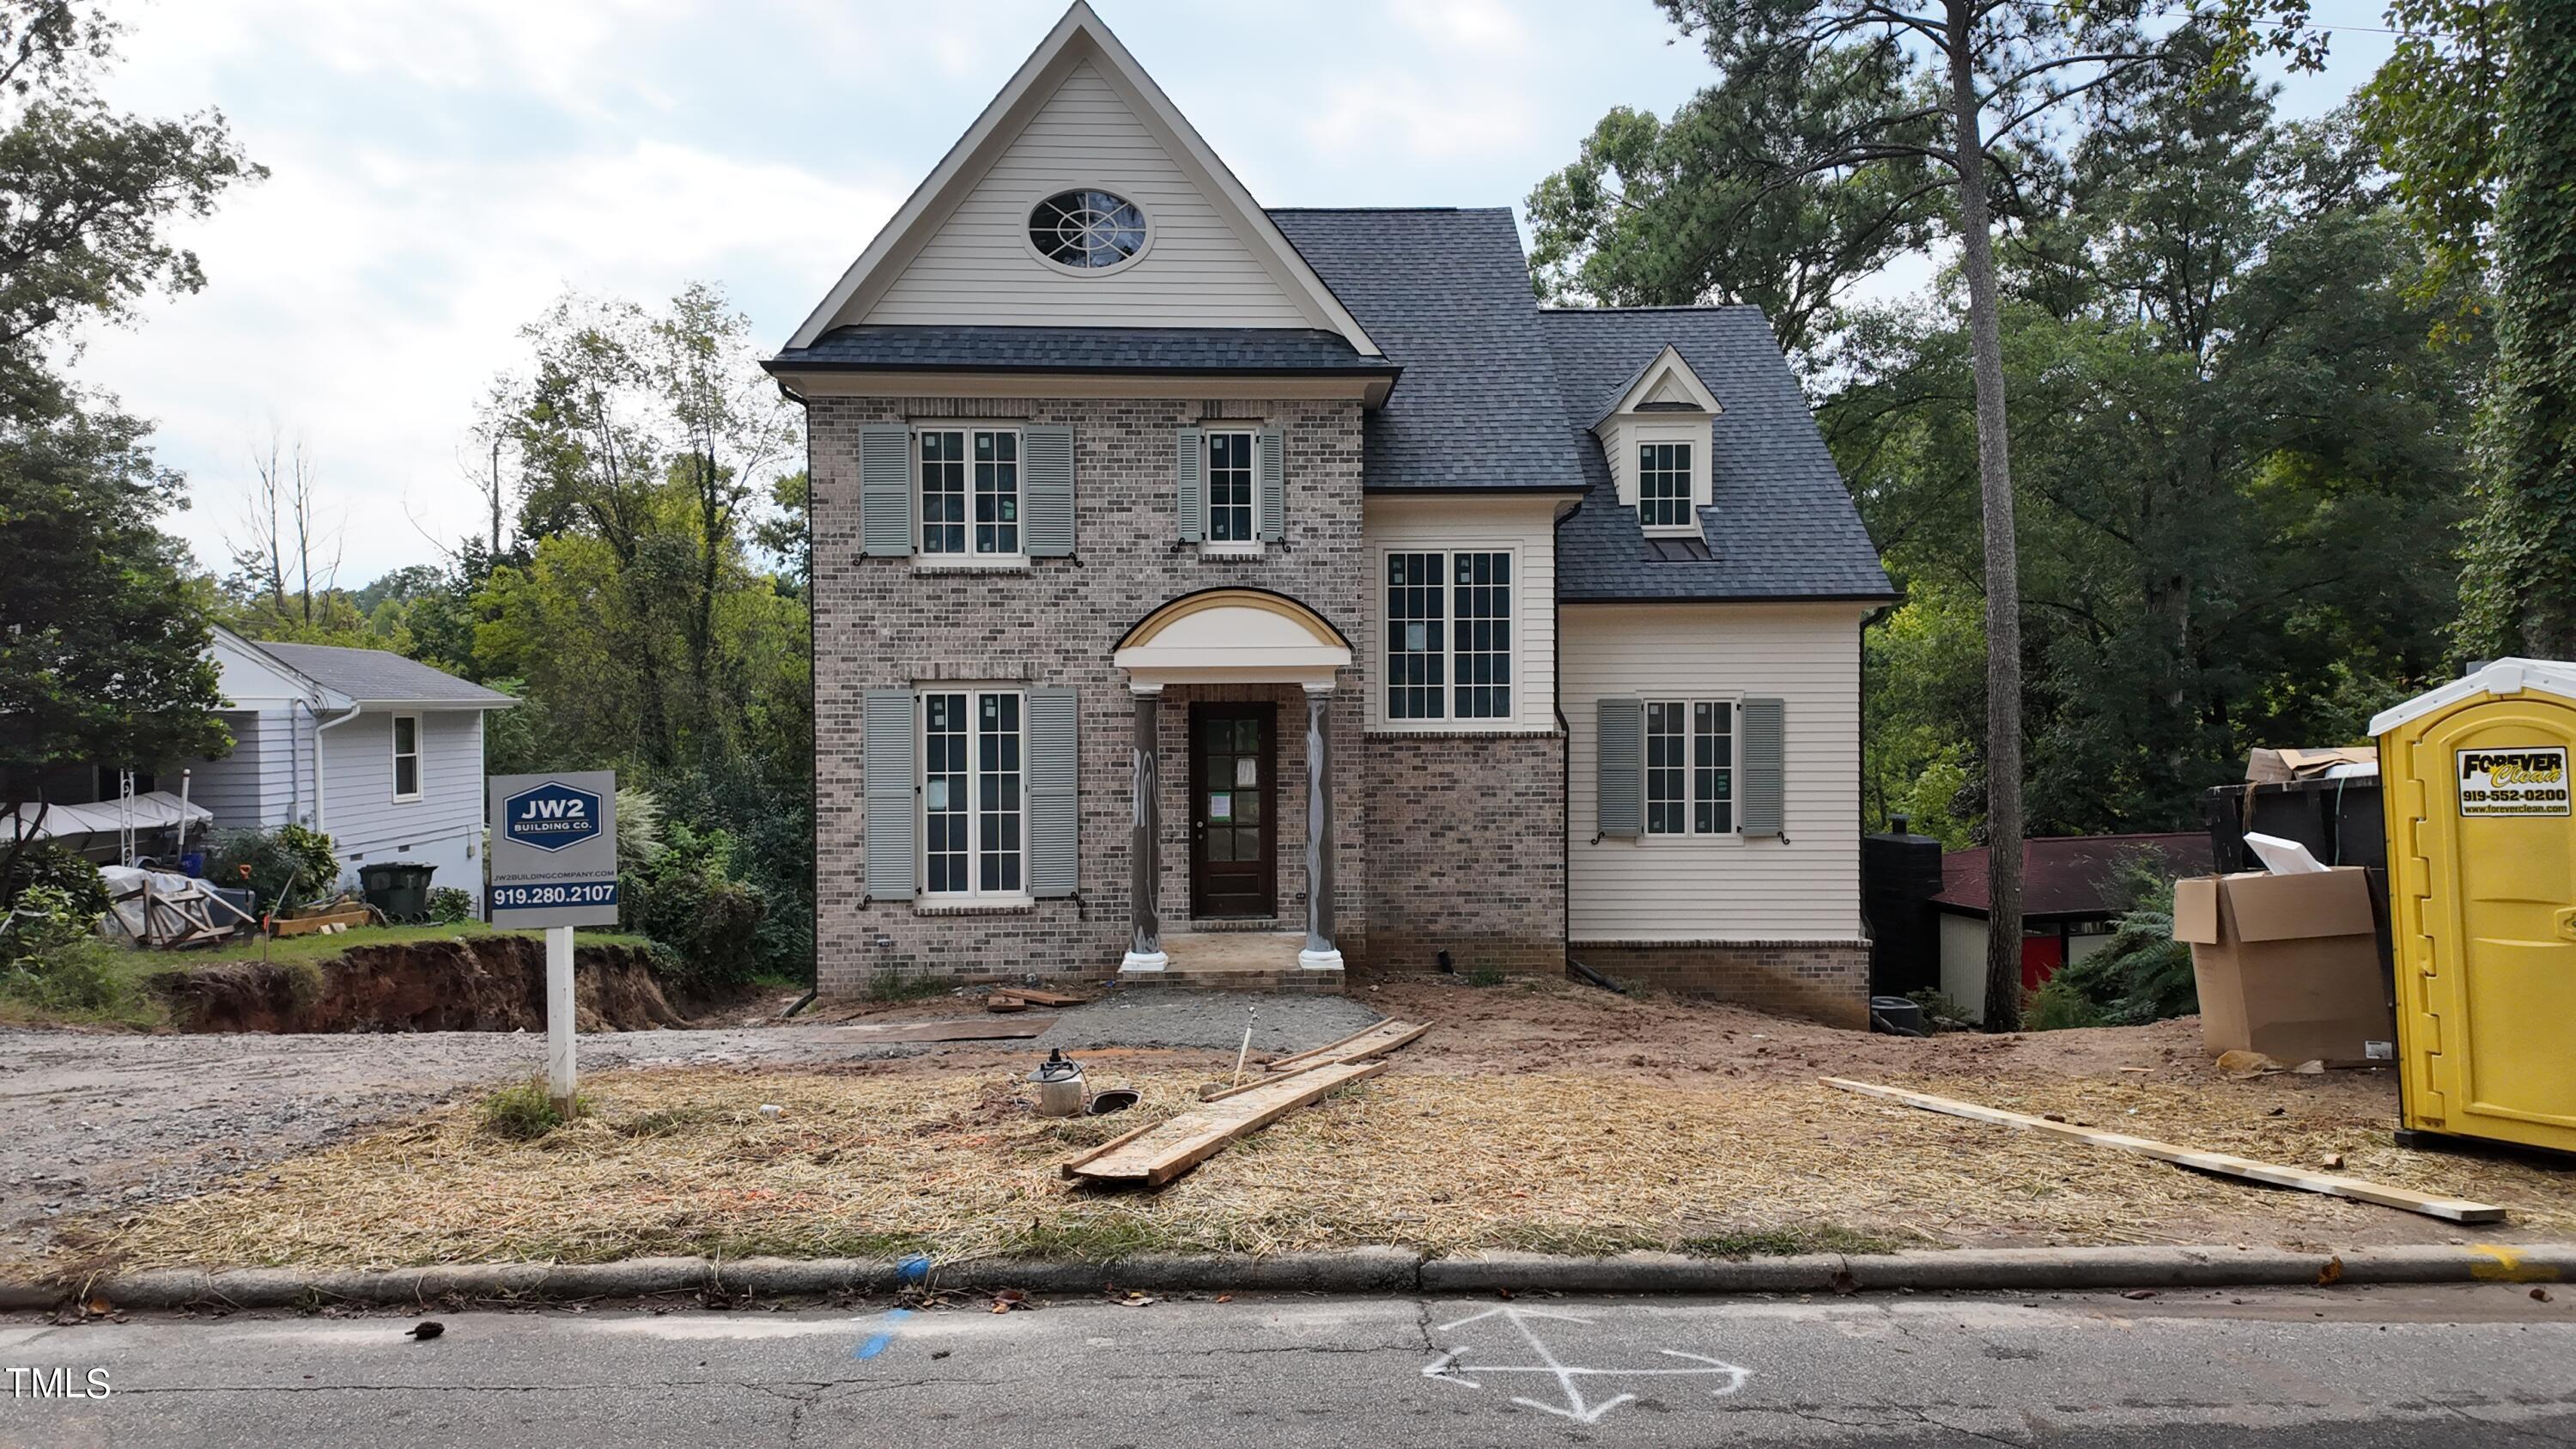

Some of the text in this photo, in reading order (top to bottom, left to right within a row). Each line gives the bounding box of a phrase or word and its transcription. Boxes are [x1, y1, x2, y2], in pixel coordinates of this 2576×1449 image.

[2463, 753, 2561, 779] FOREVER
[2491, 764, 2561, 788] Clean
[2463, 789, 2567, 801] 919-552-0200
[521, 799, 585, 819] JW2
[2464, 804, 2567, 813] www.foreverclean.com
[514, 821, 592, 832] BUILDING CO.
[494, 870, 614, 881] JW2BUILDINGCOMPANY.COM
[494, 885, 615, 904] 919.280.2107
